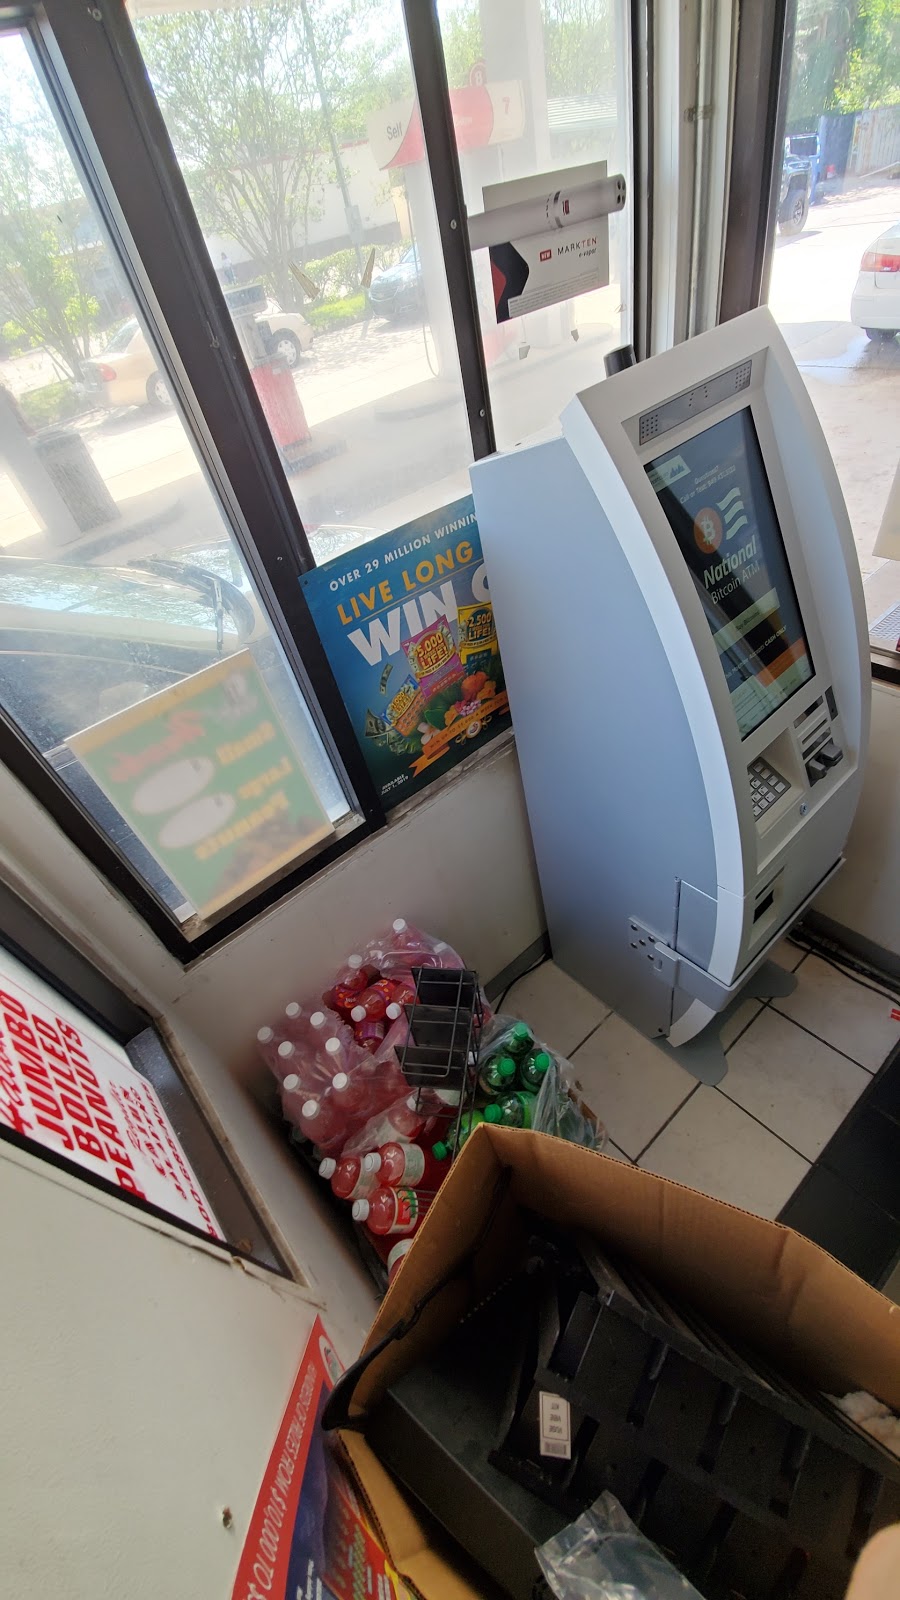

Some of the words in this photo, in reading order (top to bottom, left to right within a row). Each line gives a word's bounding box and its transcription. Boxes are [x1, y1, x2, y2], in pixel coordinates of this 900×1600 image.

[386, 121, 402, 140] Self
[557, 238, 597, 256] MARKTEN
[578, 248, 596, 258] e-vapor
[329, 568, 362, 592] OVER
[365, 558, 380, 573] 29
[384, 535, 431, 568] MILLION
[335, 579, 393, 626] LIVE
[404, 540, 473, 590] LONG
[703, 535, 757, 588] National
[711, 577, 741, 604] Bitcoin
[741, 561, 760, 581] ATM
[347, 581, 458, 666] WIN
[468, 628, 491, 640] LIFE!
[764, 635, 776, 646] CASH
[421, 646, 448, 670] LIFE!
[381, 774, 405, 790] AVAILABLE
[0, 990, 74, 1150] JUMBO
[32, 1014, 108, 1162] BOILED
[55, 1017, 147, 1200] PEANUTS
[276, 1444, 295, 1499] FROM
[260, 1490, 288, 1556] $10,000
[252, 1554, 274, 1586] TO
